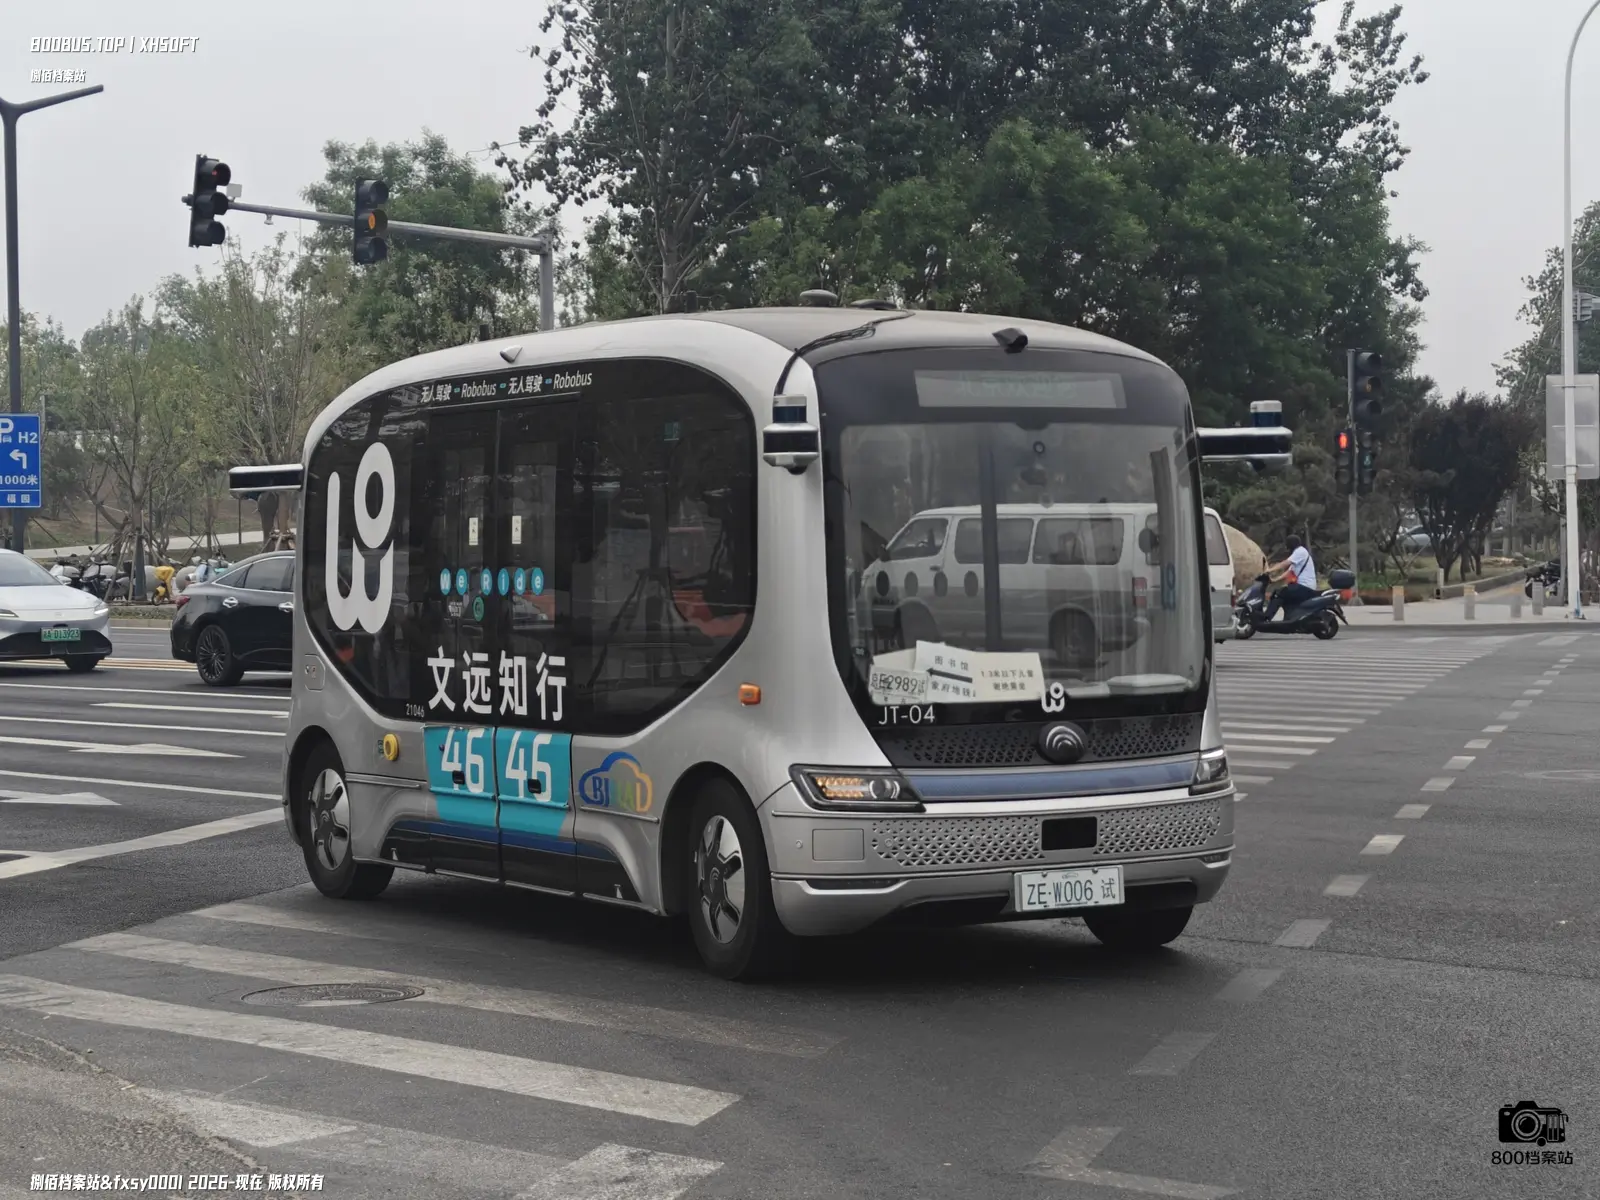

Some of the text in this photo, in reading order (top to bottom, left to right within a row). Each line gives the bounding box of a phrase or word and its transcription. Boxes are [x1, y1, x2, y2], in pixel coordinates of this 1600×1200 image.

[420, 369, 594, 403] 无人驾驶 Robobus 无人驾驶 Robobus
[18, 431, 38, 444] H2
[427, 645, 567, 721] 文远知行
[878, 704, 936, 725] JT-04
[441, 727, 552, 803] 46 46
